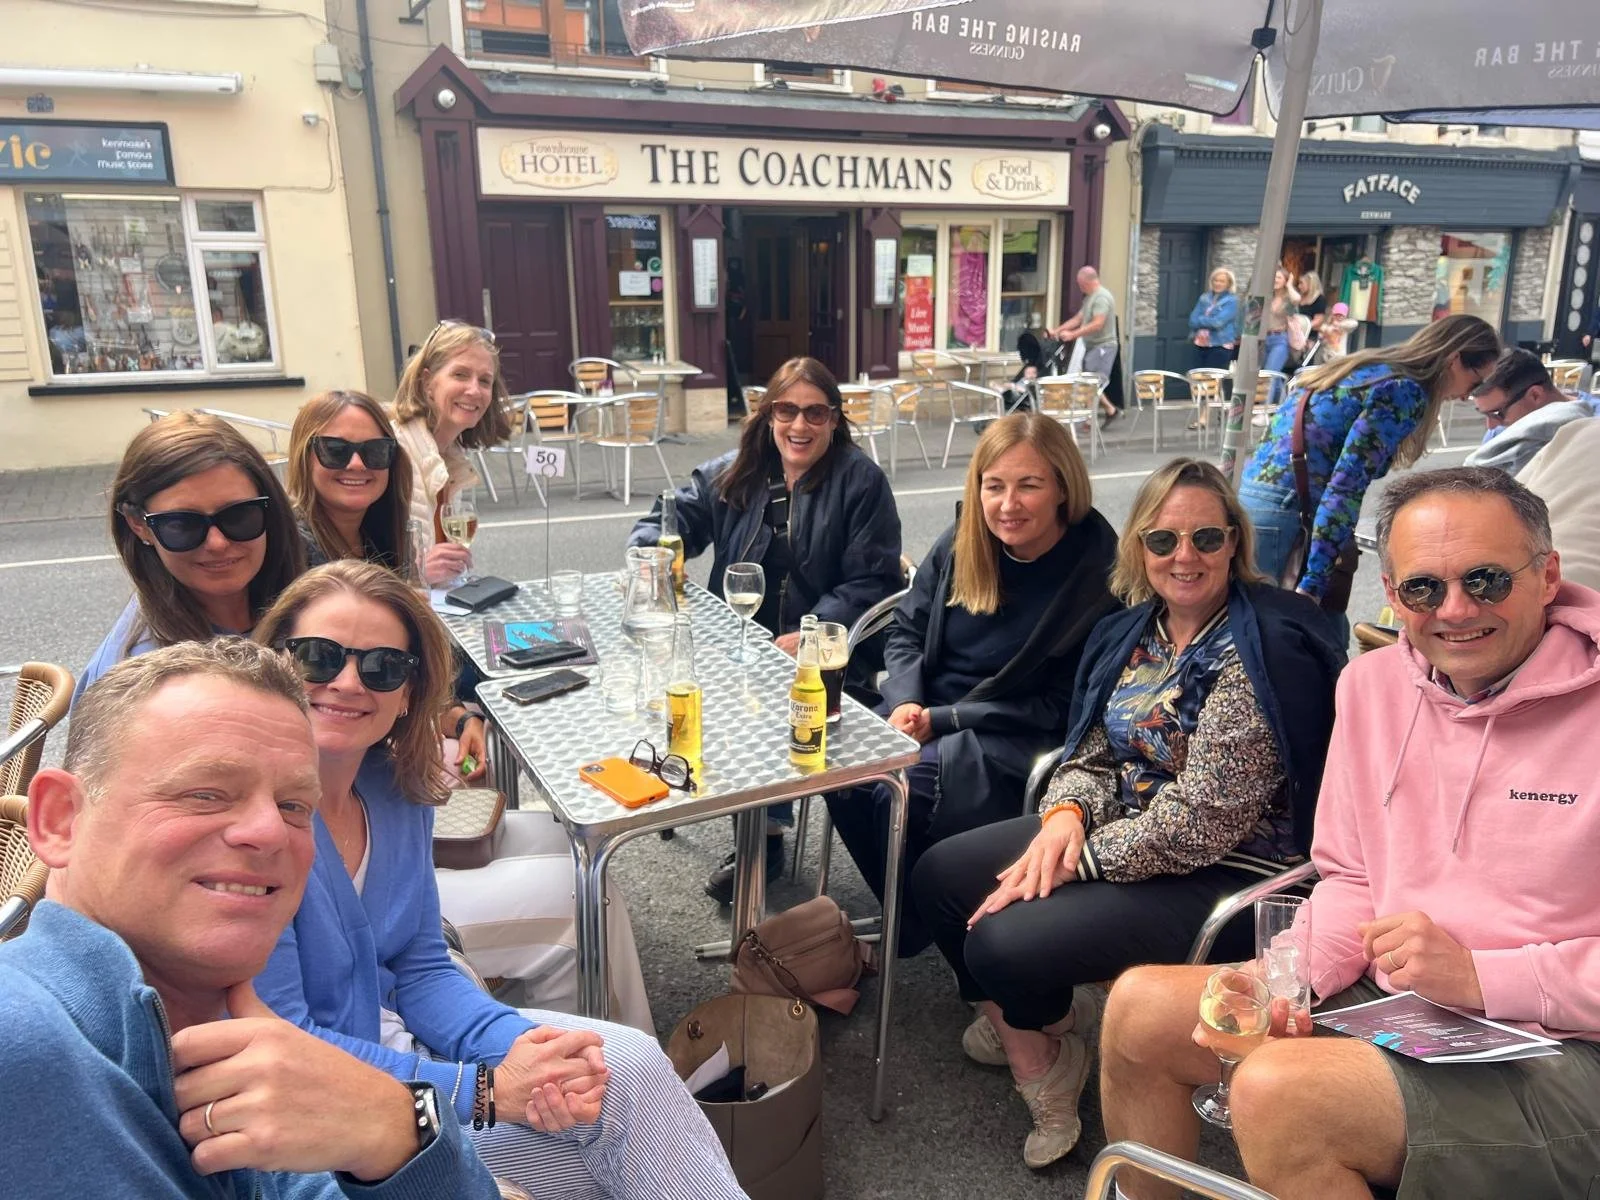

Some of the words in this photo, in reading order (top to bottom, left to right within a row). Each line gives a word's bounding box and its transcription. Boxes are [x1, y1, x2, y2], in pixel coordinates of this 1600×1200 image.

[520, 154, 602, 174] HOTEL
[641, 144, 720, 185] THE
[739, 147, 952, 191] COACHMANS
[999, 159, 1032, 174] Food
[986, 173, 999, 190] &
[1005, 174, 1042, 192] Drink
[1343, 173, 1421, 204] FATFACE
[536, 451, 557, 465] 50
[1509, 789, 1578, 805] kenergy
